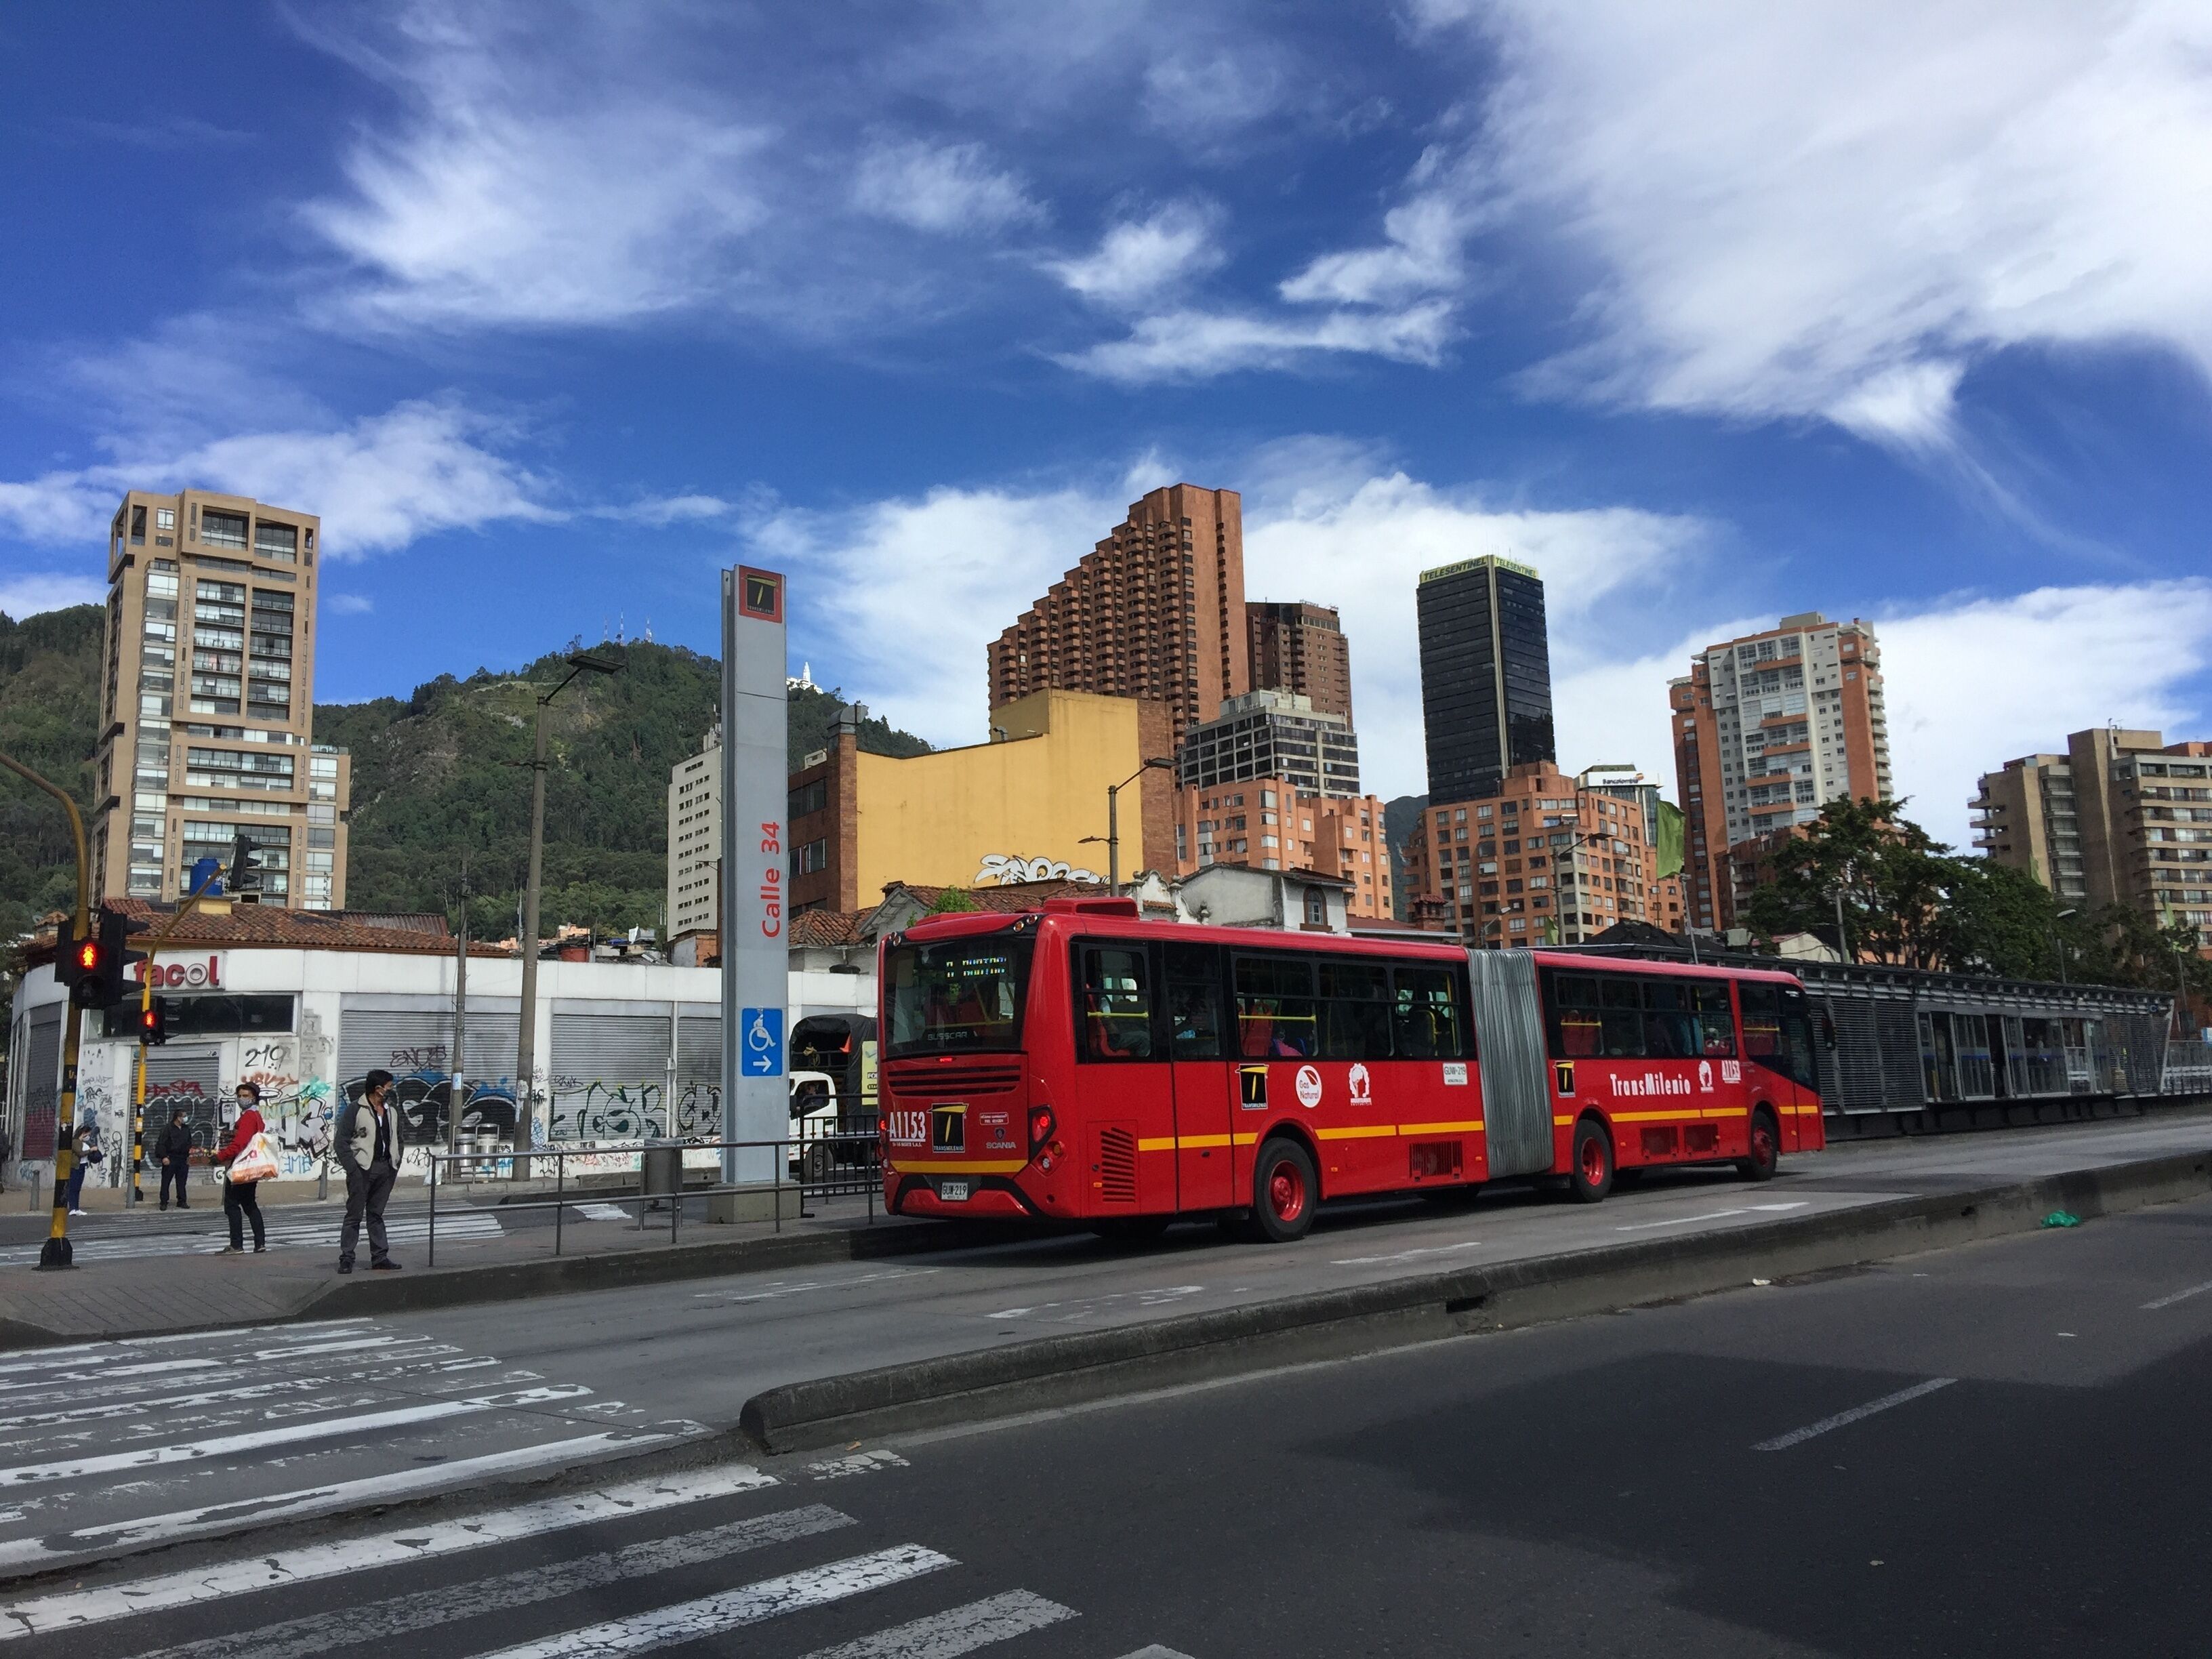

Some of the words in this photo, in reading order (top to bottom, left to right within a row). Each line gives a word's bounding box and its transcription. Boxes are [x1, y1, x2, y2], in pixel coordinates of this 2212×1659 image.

[1424, 557, 1487, 581] TELESENTINEL
[1495, 557, 1537, 577] TELESENTINEL
[761, 821, 779, 855] 34
[760, 867, 780, 938] Calle
[927, 1031, 968, 1041] BUSSCAR
[1610, 1071, 1691, 1097] TransMilenio
[889, 1111, 926, 1139] A1153
